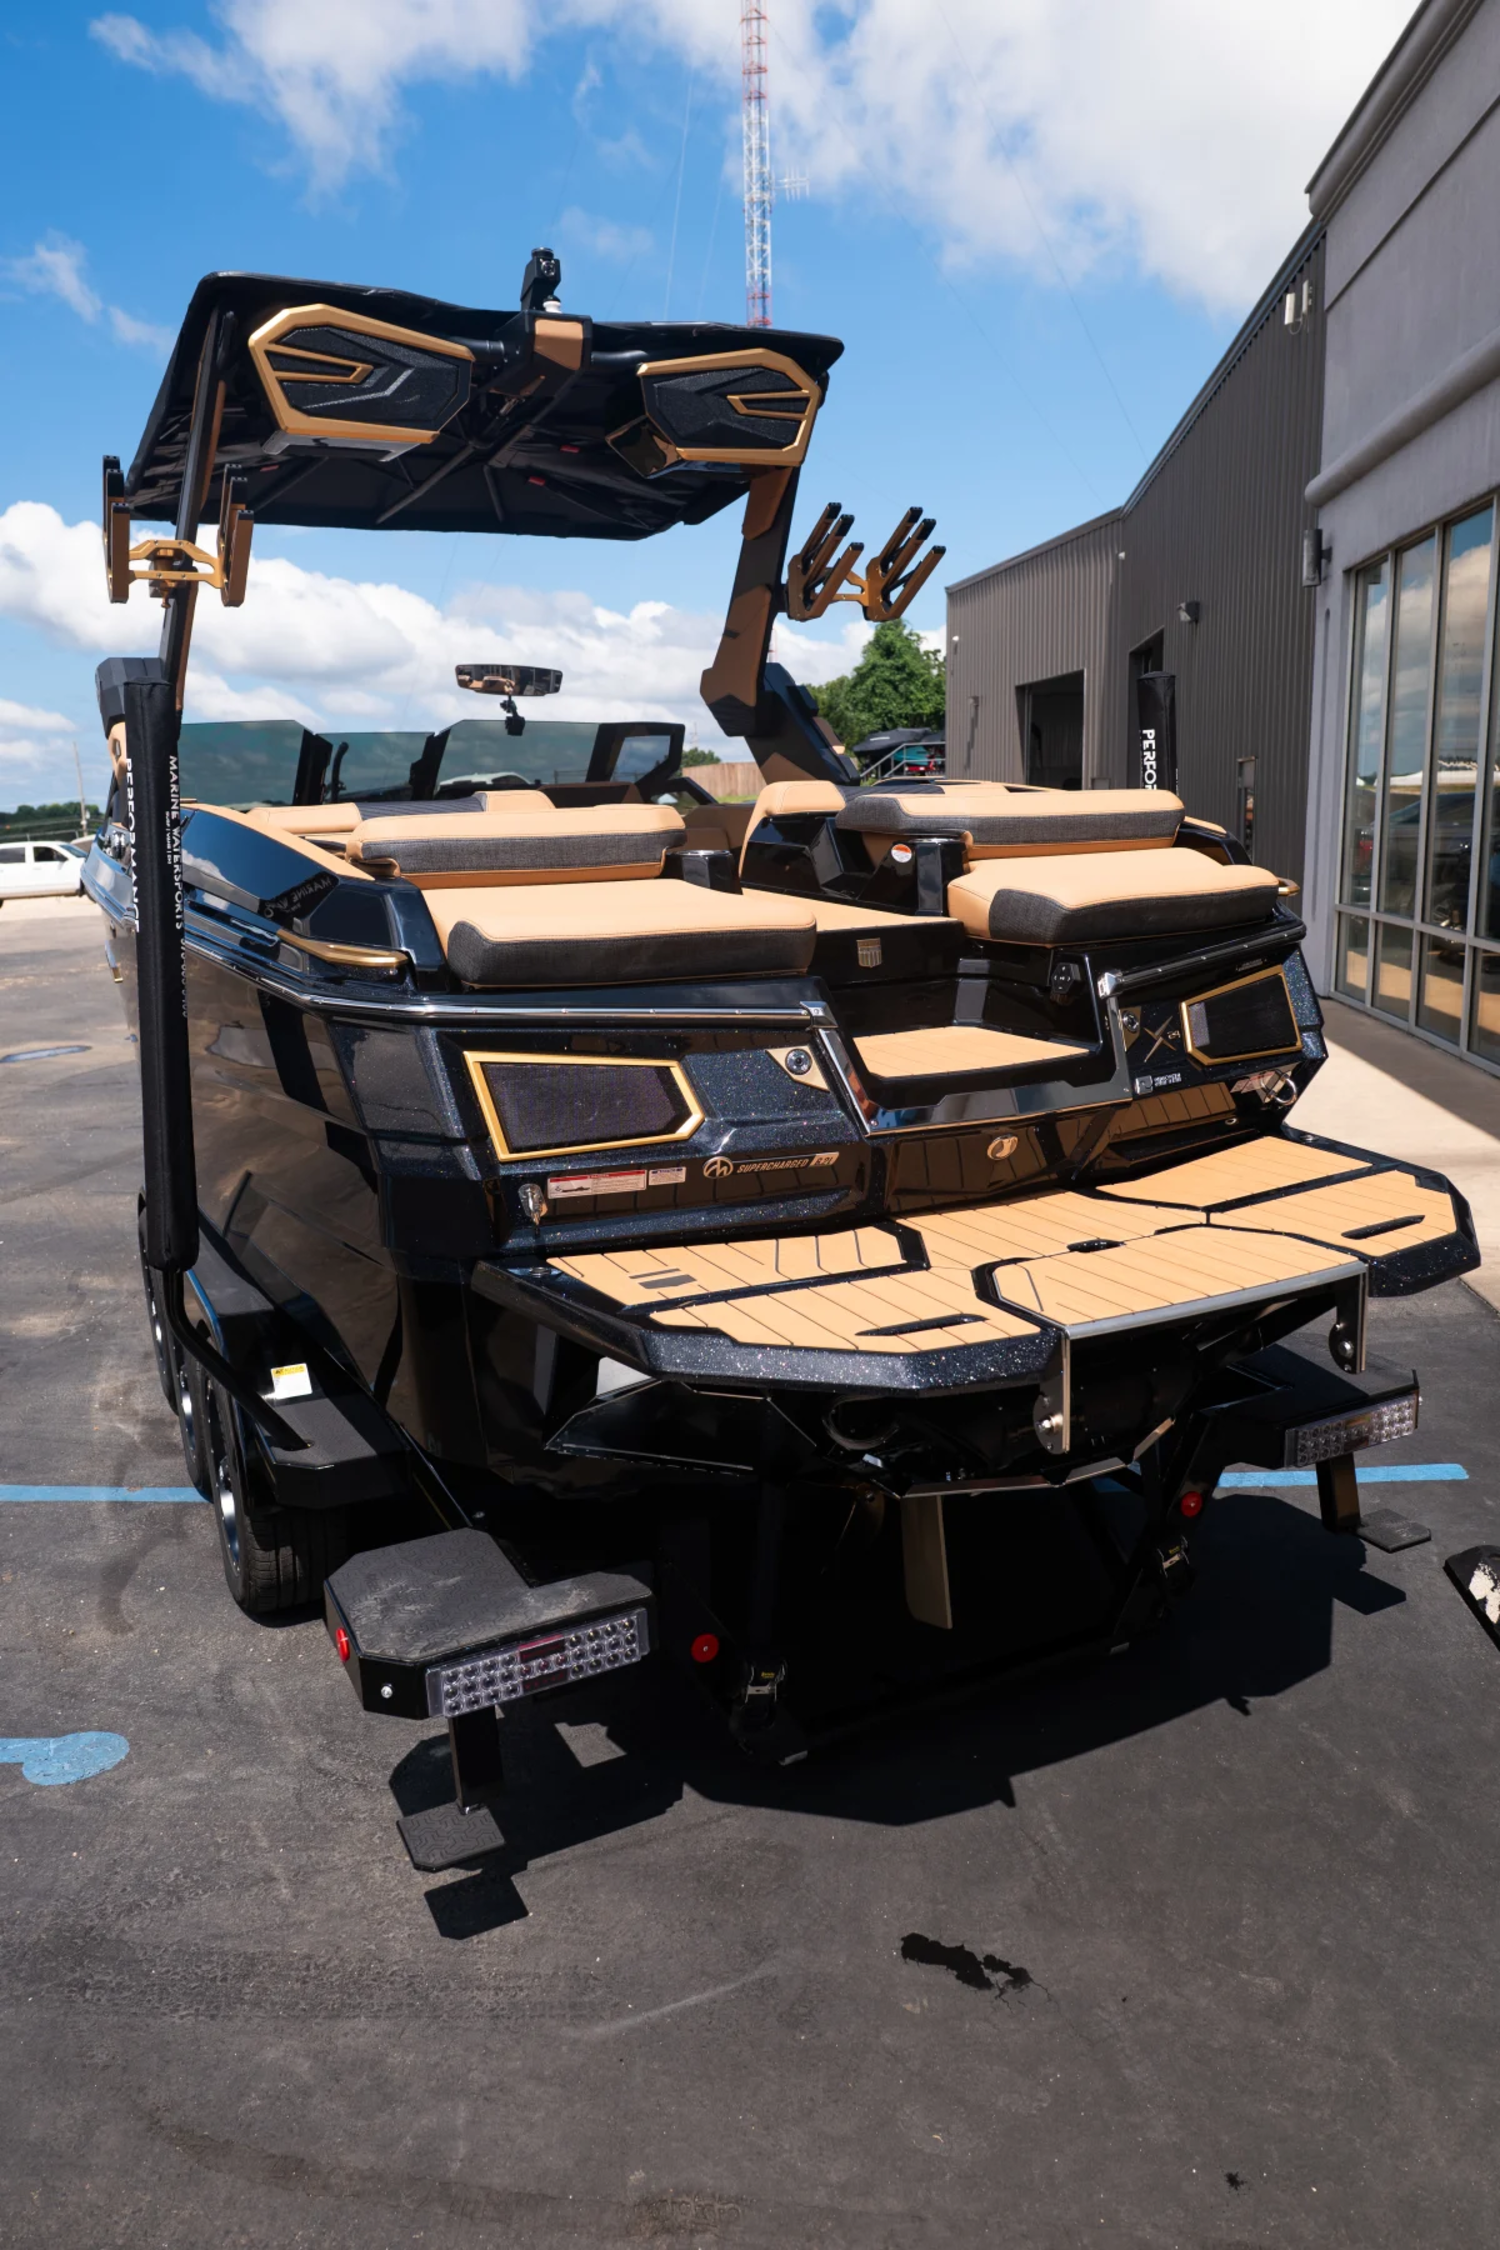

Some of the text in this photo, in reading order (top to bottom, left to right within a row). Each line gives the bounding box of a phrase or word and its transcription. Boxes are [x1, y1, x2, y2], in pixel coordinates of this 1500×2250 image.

[169, 755, 181, 820] MARINE
[172, 826, 184, 930] WATERSPORTS
[736, 1158, 810, 1174] SUPERCHARGED
